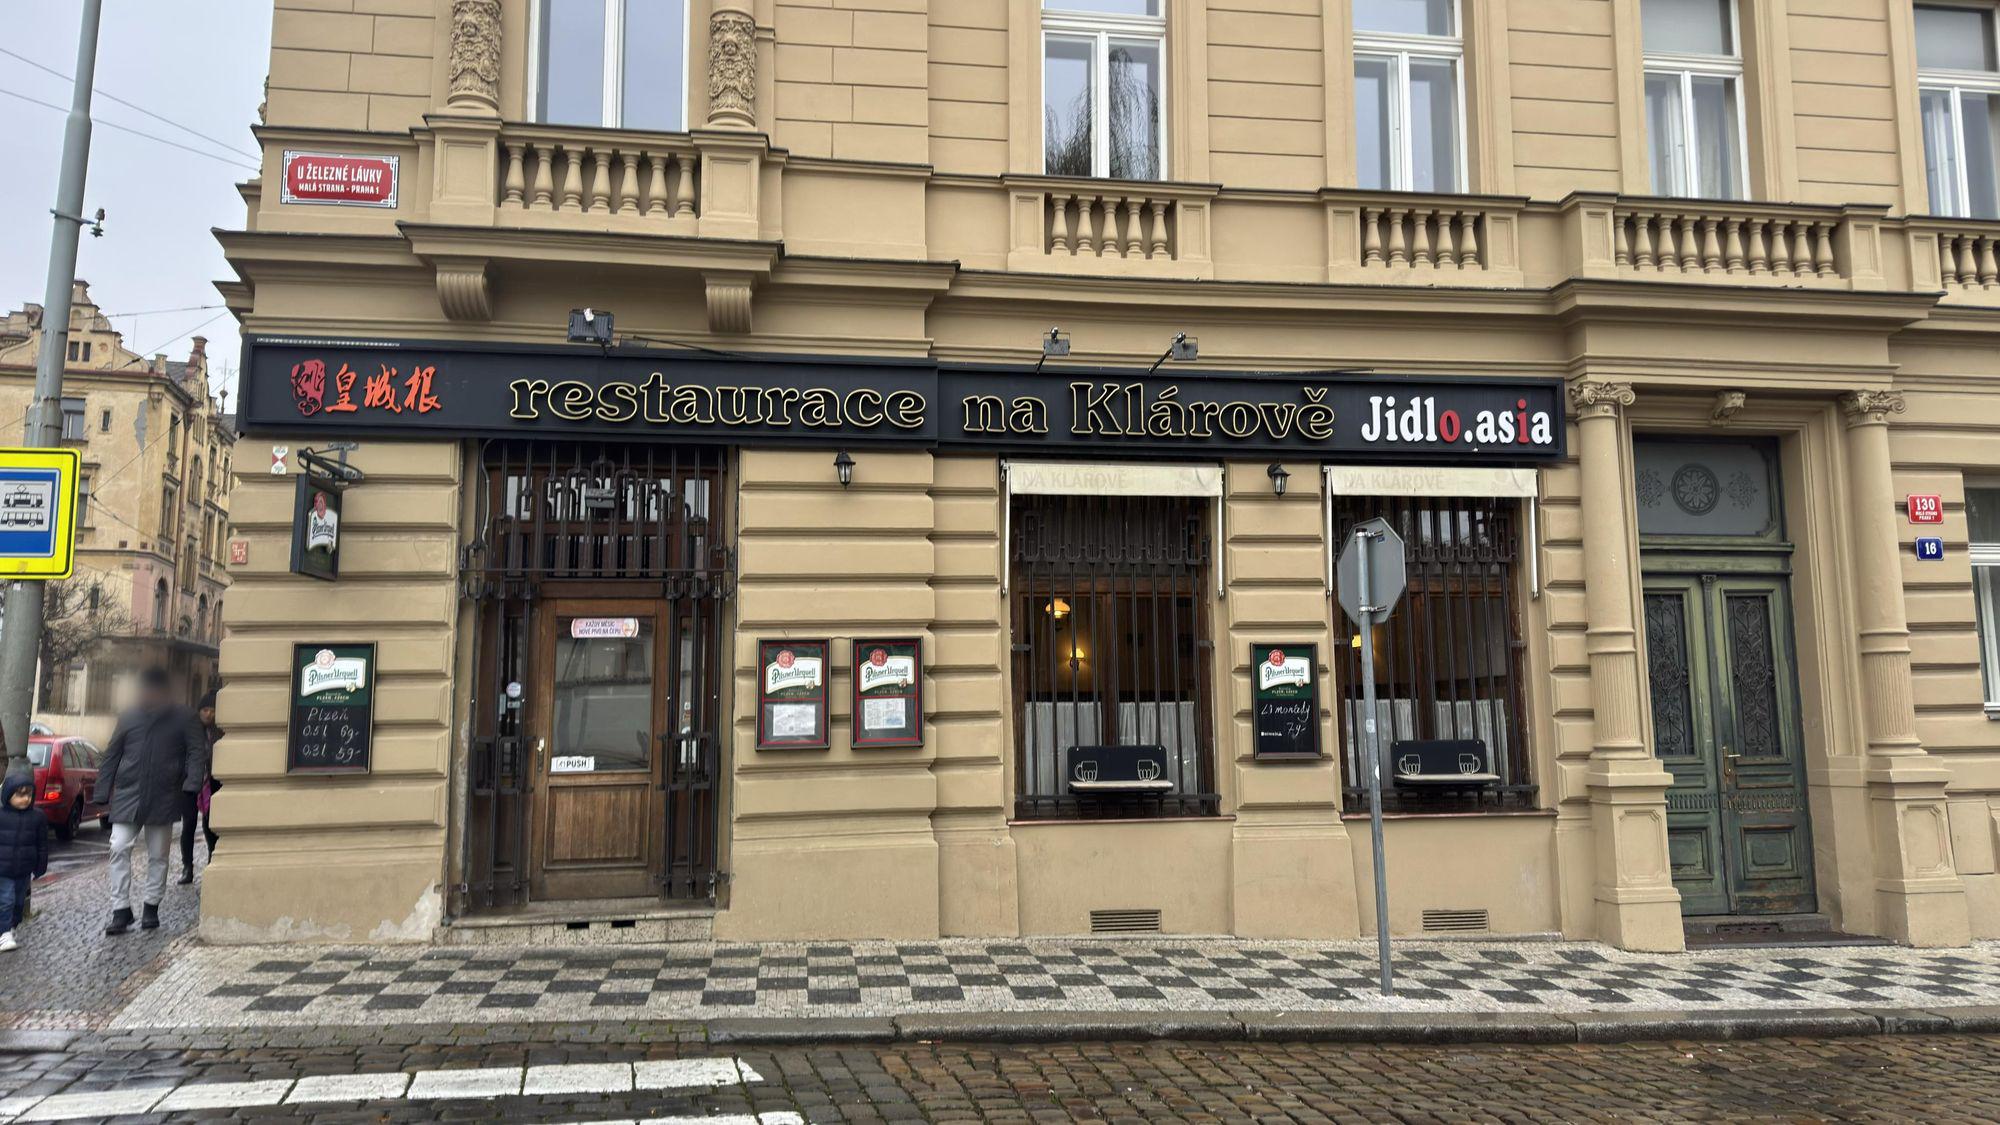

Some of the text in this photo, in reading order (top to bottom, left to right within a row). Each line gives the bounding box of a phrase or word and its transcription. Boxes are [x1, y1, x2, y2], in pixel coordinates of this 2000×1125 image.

[297, 163, 383, 183] U ŽELEZNÉ LÁVKY
[298, 182, 317, 192] MALÁ
[318, 184, 345, 193] STRANA
[351, 185, 374, 194] PRAHA
[375, 186, 380, 195] 1
[509, 372, 1336, 439] restaurace na Klárově
[1360, 396, 1553, 445] Jidlo.asia
[1022, 471, 1048, 489] NA
[1916, 497, 1936, 511] 130
[1925, 542, 1937, 555] 16
[309, 668, 358, 686] Pilsner Urquell
[772, 667, 815, 684] Pilsner Urquell
[866, 666, 908, 683] Pilsner Urquell
[1265, 666, 1304, 681] Pilsner Urquell
[566, 759, 587, 768] PUSH
